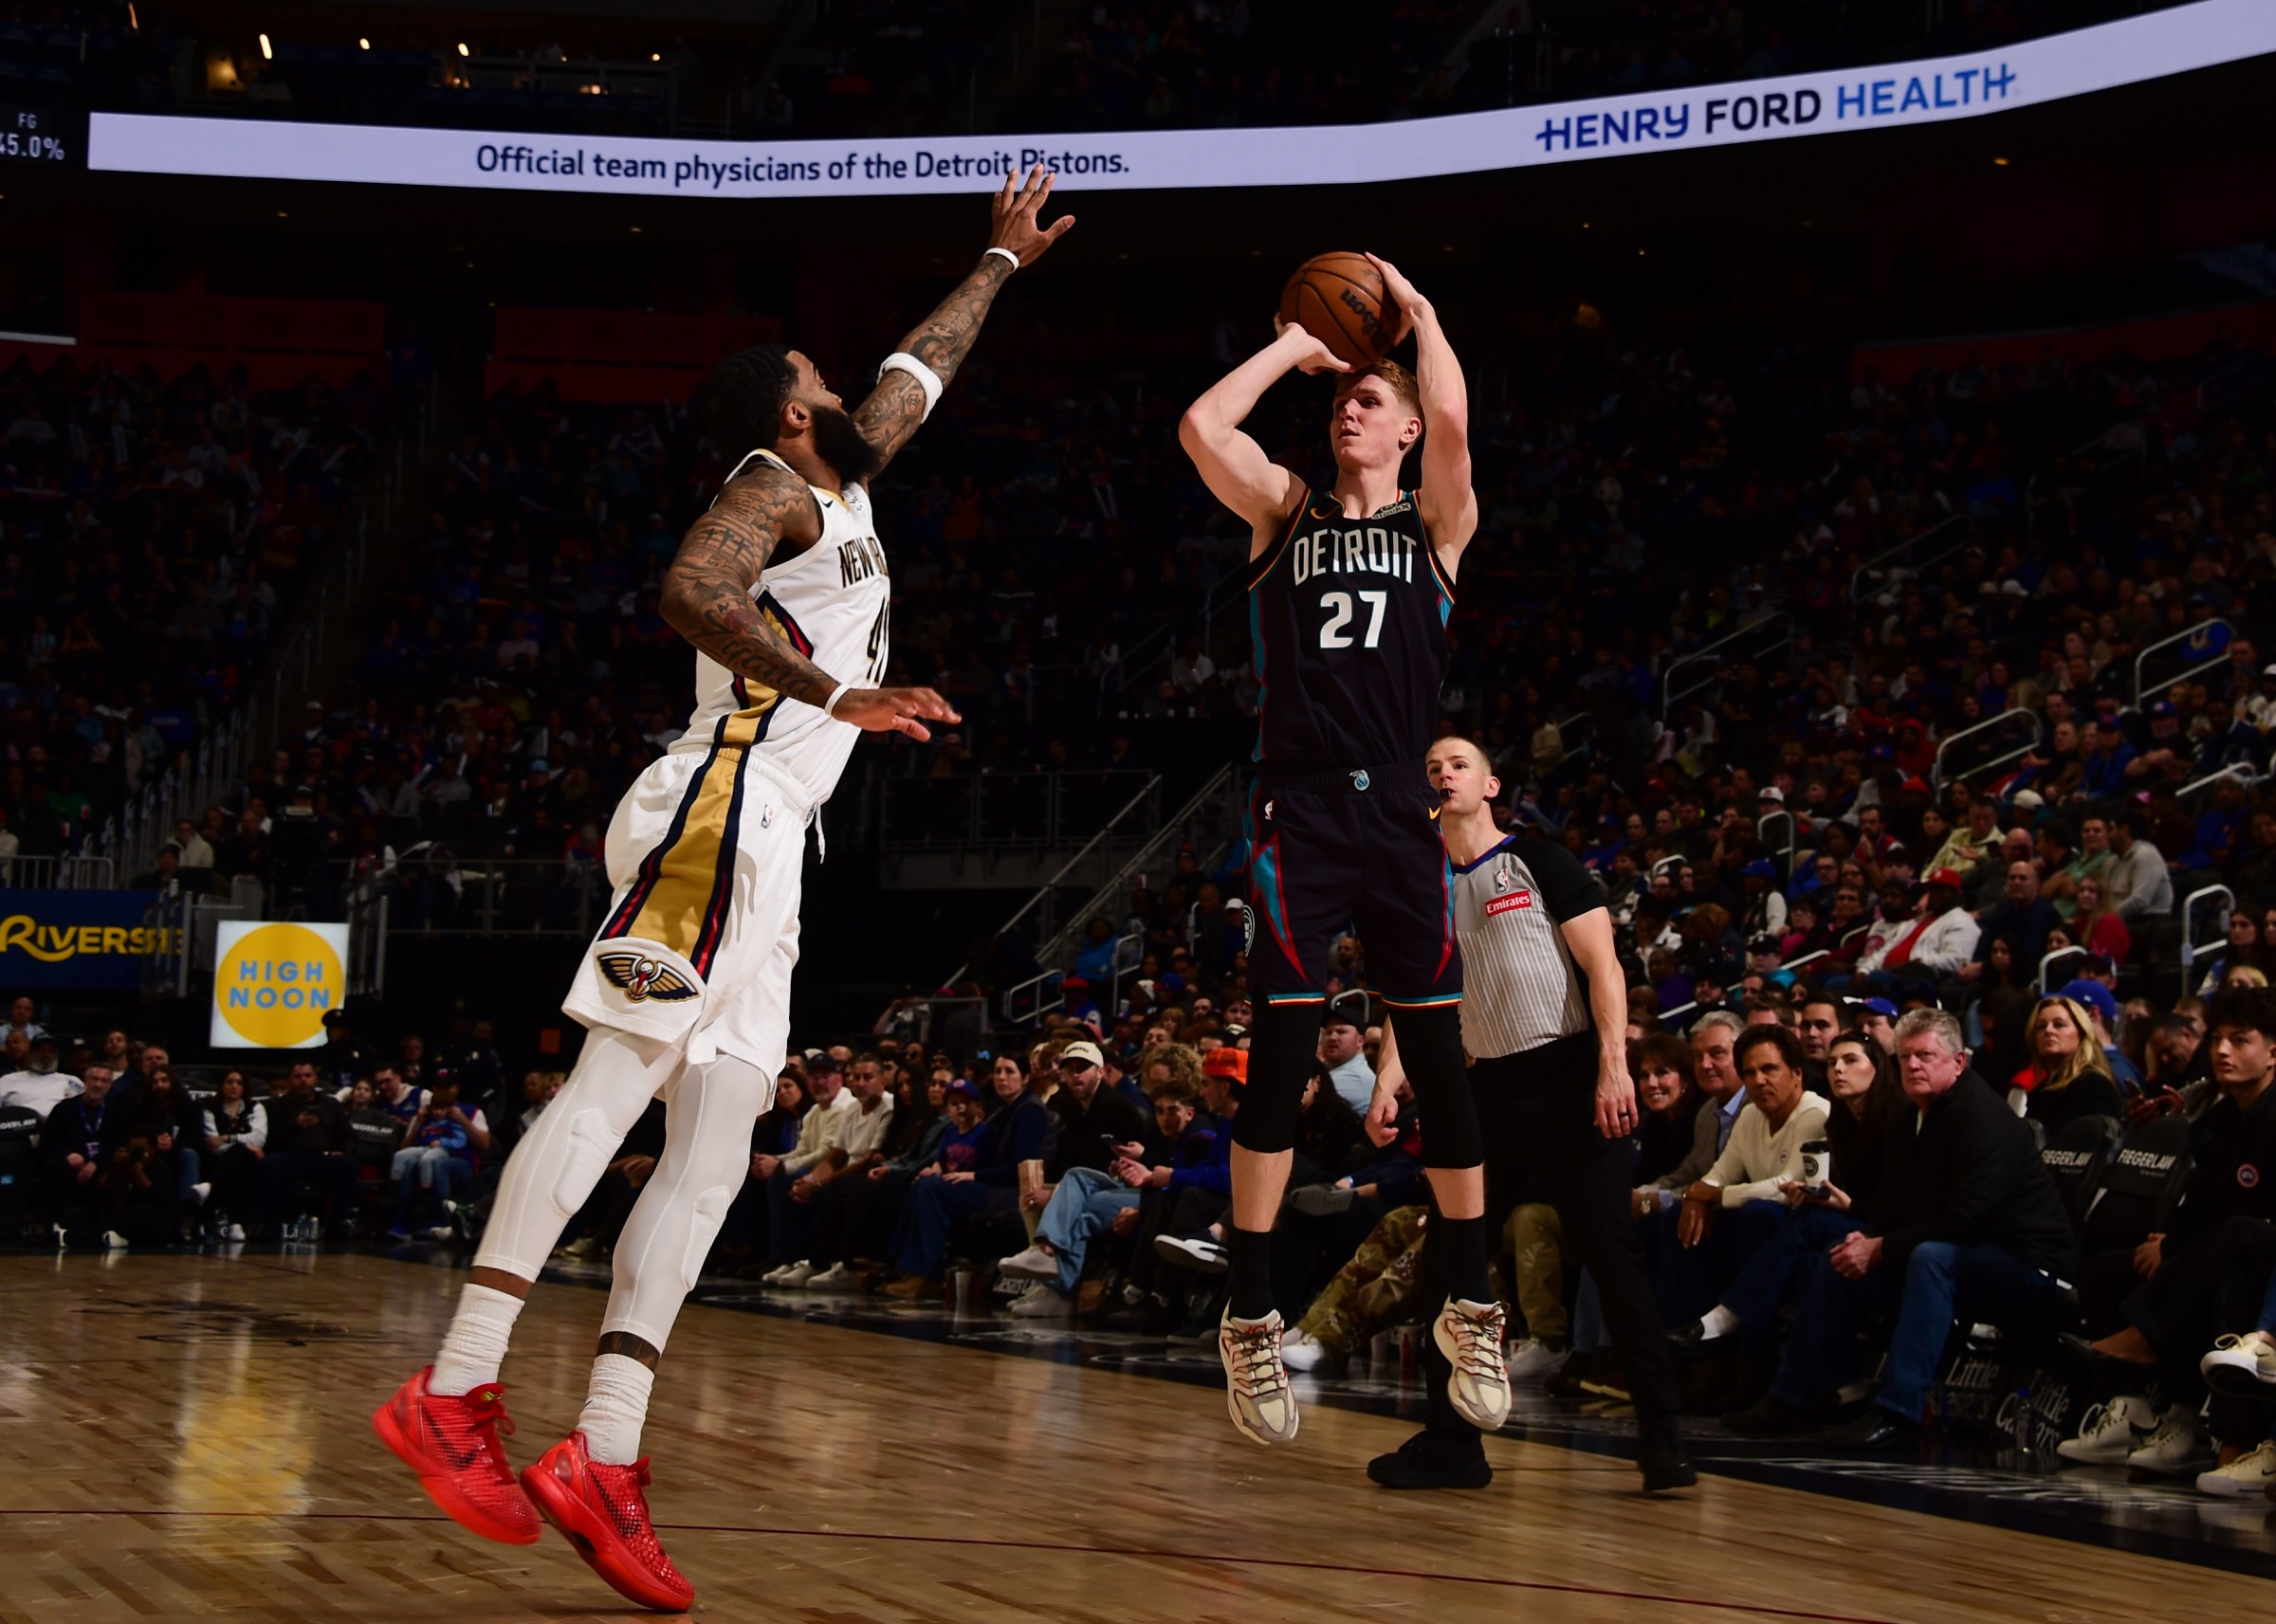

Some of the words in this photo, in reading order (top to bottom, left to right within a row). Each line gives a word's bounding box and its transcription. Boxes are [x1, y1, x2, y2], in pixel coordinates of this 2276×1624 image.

[18, 112, 38, 129] FG
[1536, 103, 1689, 152] HENRY
[1707, 90, 1821, 134] FORD
[1837, 64, 2016, 119] HEALTH
[477, 145, 584, 175] Official
[594, 154, 666, 179] team
[675, 155, 820, 189] physicians
[828, 154, 857, 180] of
[865, 153, 908, 178] the
[916, 151, 1012, 177] Detroit
[837, 538, 875, 590] NEW
[1294, 527, 1417, 587] DETROIT
[1319, 590, 1388, 649] 27
[1486, 895, 1531, 914] Emirates
[239, 960, 323, 982] HIGH
[229, 987, 330, 1010] NOON
[1944, 1355, 2001, 1389] Little
